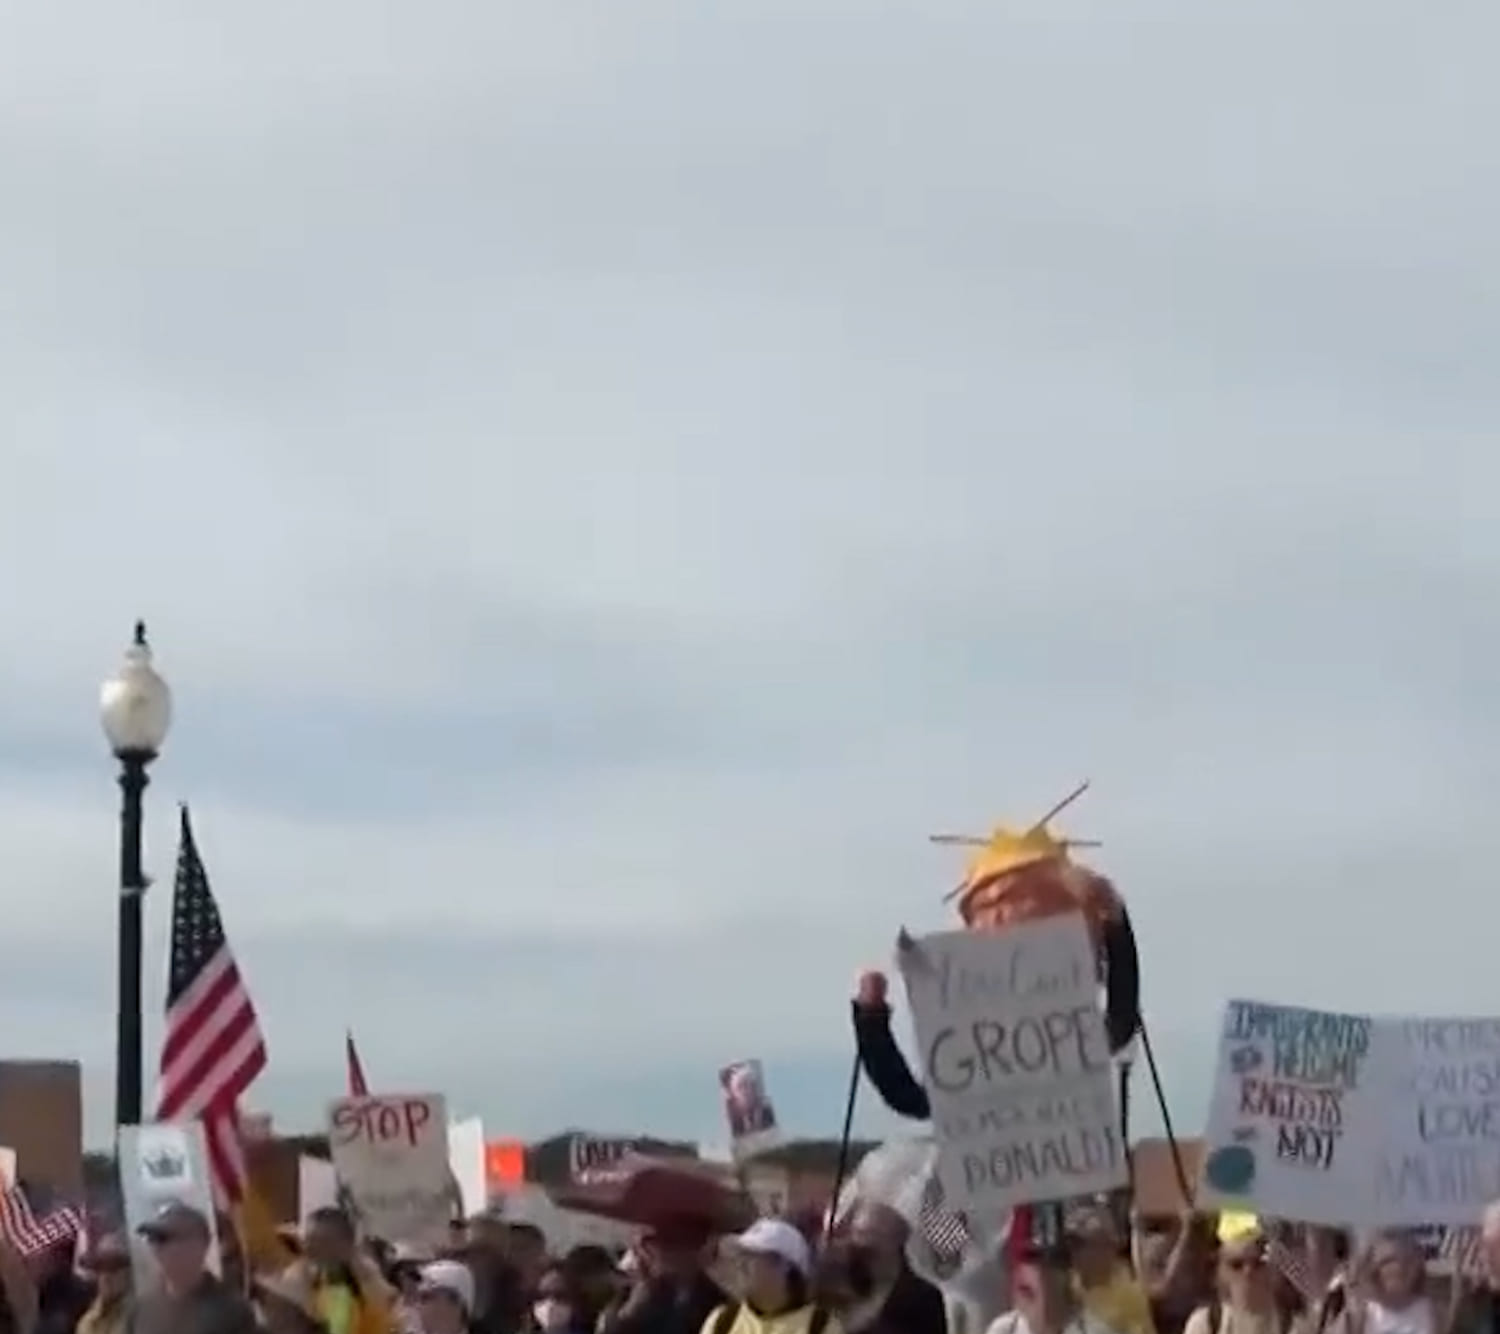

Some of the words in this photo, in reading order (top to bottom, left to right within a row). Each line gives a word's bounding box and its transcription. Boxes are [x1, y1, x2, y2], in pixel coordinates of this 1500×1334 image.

[928, 1005, 1110, 1092] GROPE
[332, 1099, 430, 1147] STOP
[1276, 1124, 1343, 1171] NOT
